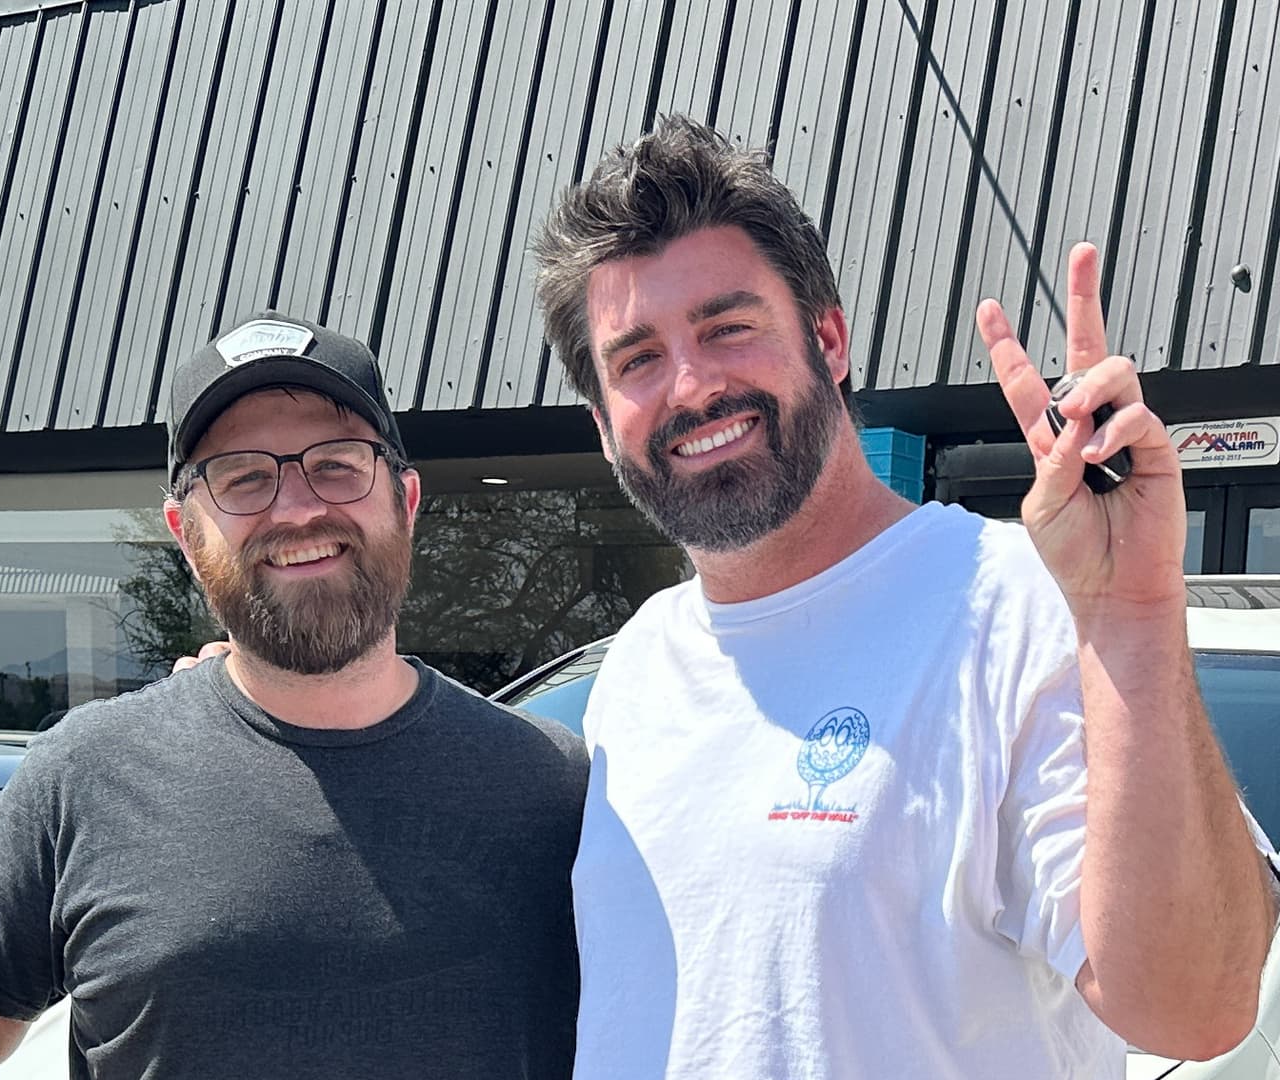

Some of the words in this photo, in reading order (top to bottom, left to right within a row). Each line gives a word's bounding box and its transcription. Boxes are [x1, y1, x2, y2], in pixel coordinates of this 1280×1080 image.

[1201, 422, 1235, 431] Protected
[1236, 421, 1245, 430] By
[1203, 437, 1265, 453] ALARM
